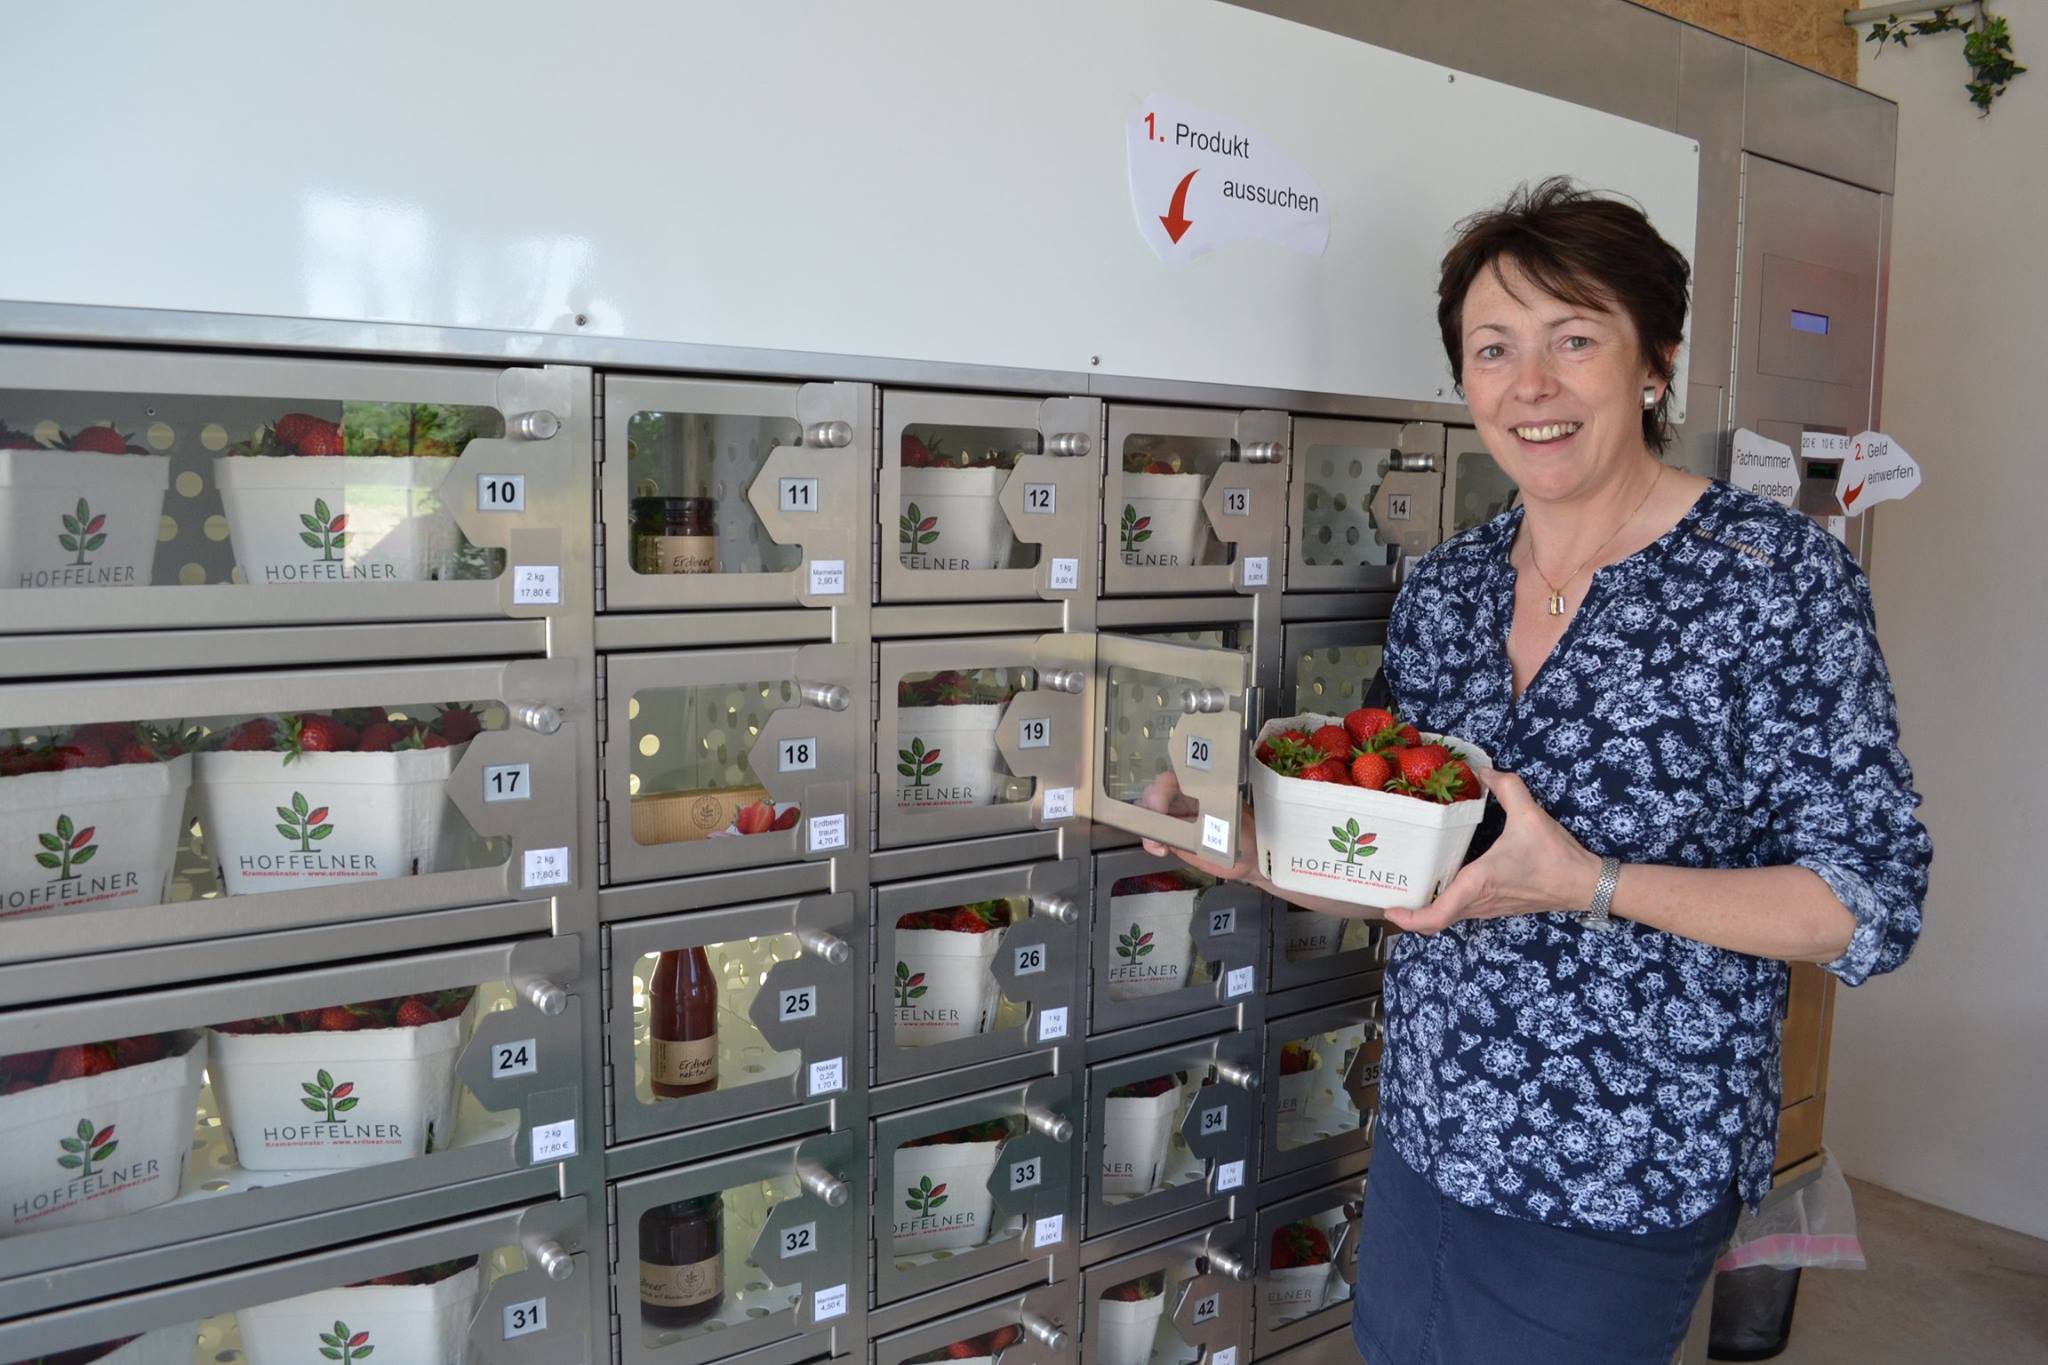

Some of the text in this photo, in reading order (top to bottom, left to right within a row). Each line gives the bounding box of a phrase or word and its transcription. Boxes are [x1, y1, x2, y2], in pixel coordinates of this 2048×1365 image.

[1145, 112, 1249, 159] 1. Produkt
[1223, 180, 1319, 213] aussuchen
[1736, 449, 1791, 469] Fachnummer
[1855, 442, 1888, 461] 2. Geld
[1868, 465, 1914, 485] einwerfen
[486, 481, 516, 503] 10
[788, 485, 809, 504] 11
[1029, 489, 1050, 507] 12
[1228, 494, 1245, 511] 13
[1392, 500, 1407, 515] 14
[1120, 553, 1178, 566] ELNER
[20, 566, 135, 588] HOFFELNER
[265, 564, 397, 580] HOFFELNER
[527, 572, 545, 583] 2 kg
[521, 588, 552, 598] 17,80 €
[1024, 722, 1044, 741] 19
[785, 744, 809, 764] 18
[1191, 741, 1209, 762] 20
[492, 770, 521, 793] 17
[897, 787, 973, 801] FELNER
[240, 855, 377, 870] HOFFELNER
[536, 855, 554, 865] 2 kg
[555, 869, 561, 877] €
[1291, 856, 1408, 886] HOFFELNER
[1213, 913, 1231, 931] 27
[1020, 950, 1040, 970] 26
[785, 993, 810, 1014] 25
[896, 1009, 960, 1021] ELNER
[499, 1046, 529, 1070] 24
[1364, 1065, 1380, 1082] 35
[1204, 1111, 1223, 1129] 34
[264, 1125, 402, 1140] HOFFELNER
[551, 1130, 561, 1138] kg
[562, 1141, 569, 1149] €
[1015, 1164, 1036, 1184] 33
[13, 1159, 160, 1217] HOFFELNER
[786, 1230, 810, 1251] 32
[512, 1306, 539, 1330] 31
[1197, 1300, 1215, 1317] 42
